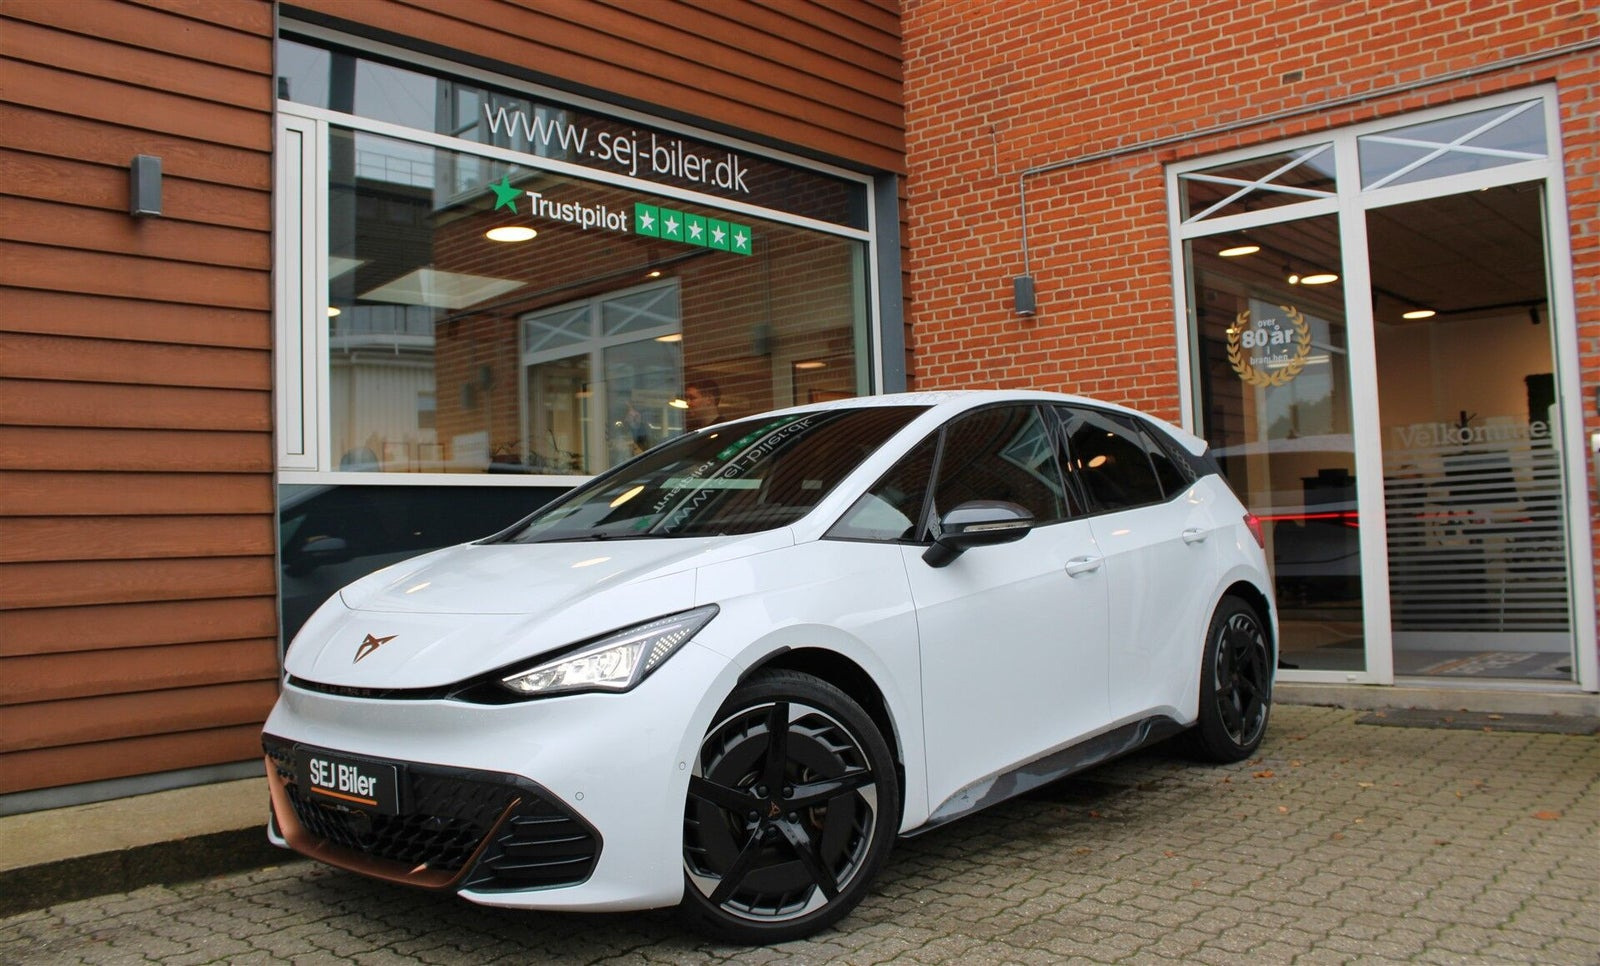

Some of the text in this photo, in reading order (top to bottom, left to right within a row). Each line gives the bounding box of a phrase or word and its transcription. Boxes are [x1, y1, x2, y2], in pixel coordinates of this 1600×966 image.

[485, 103, 750, 193] www.sej-biler.dk
[526, 191, 628, 232] Trustpilot
[1242, 324, 1294, 348] 80 år
[1257, 318, 1276, 328] over
[1396, 418, 1552, 448] Velkomme
[310, 758, 377, 797] SEJ Biler
